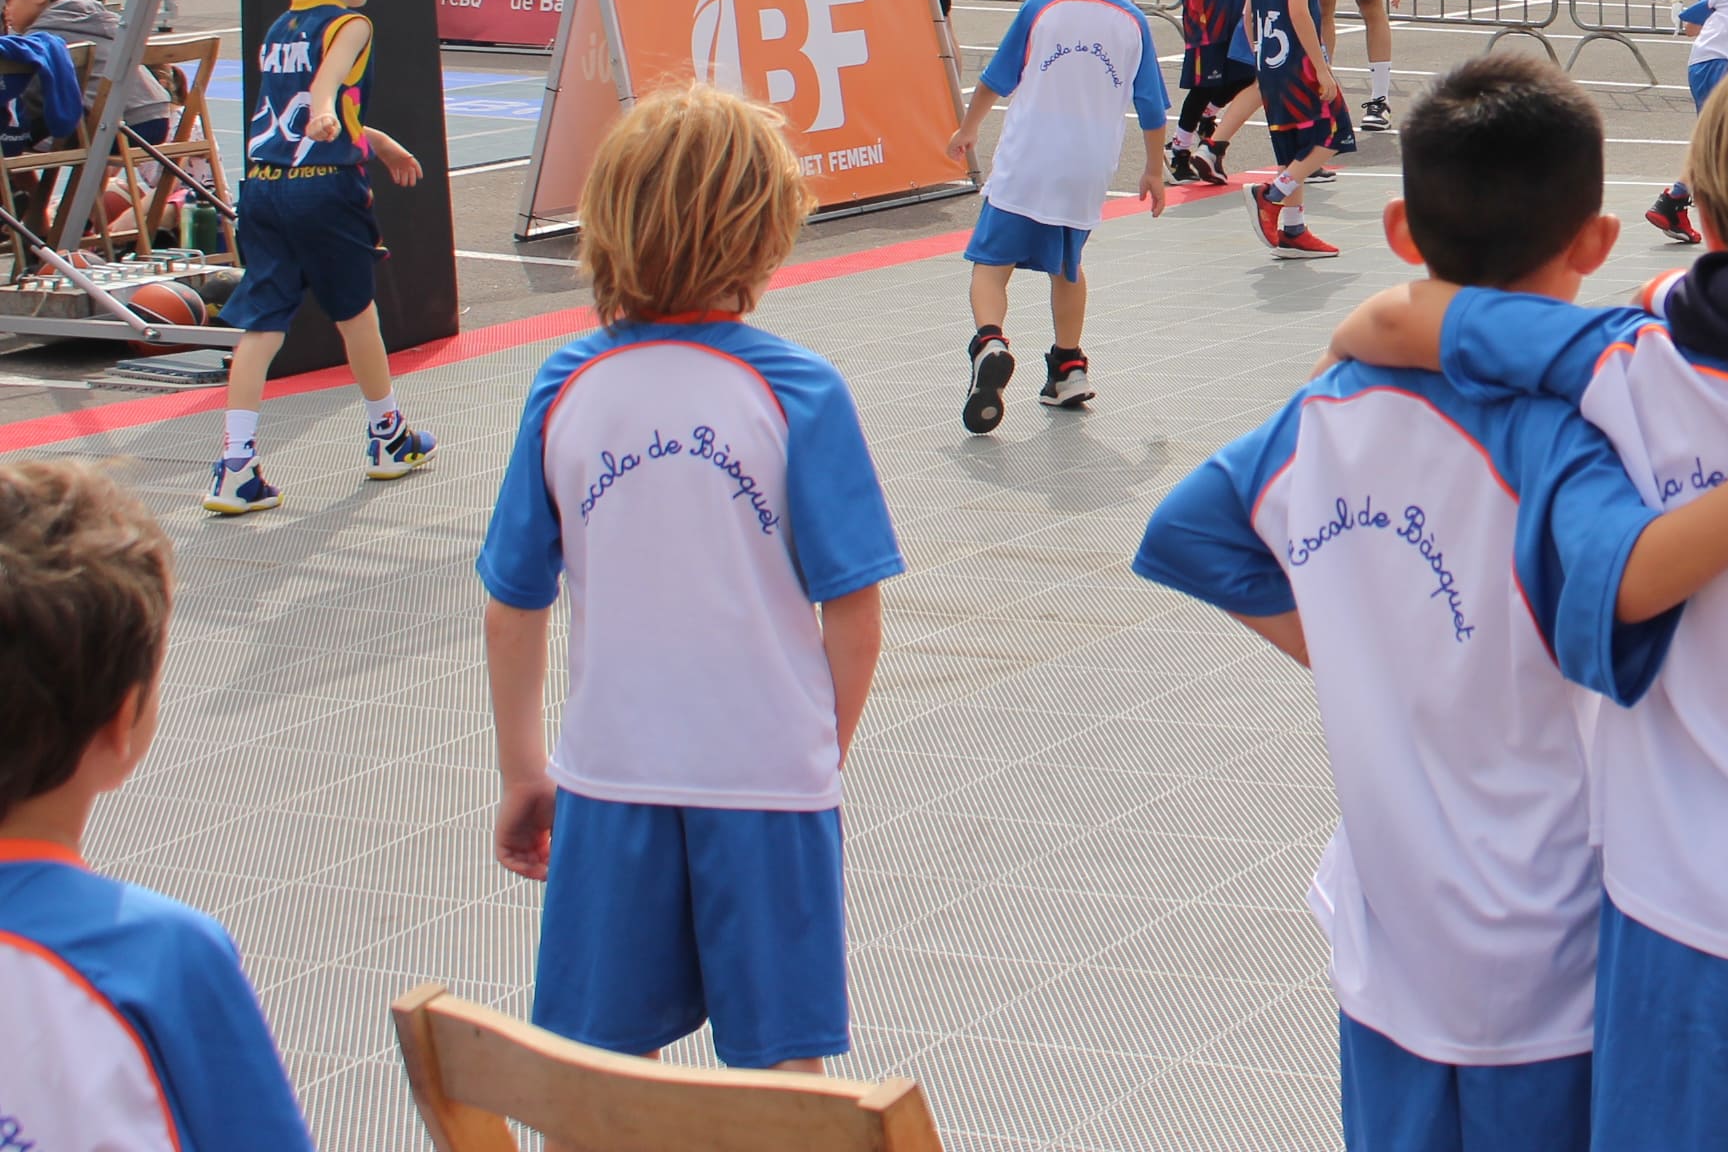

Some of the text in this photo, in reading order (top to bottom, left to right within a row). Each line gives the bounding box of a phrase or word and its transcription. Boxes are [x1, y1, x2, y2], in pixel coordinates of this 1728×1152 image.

[829, 137, 884, 173] FEMENÍ
[648, 430, 683, 459] de
[689, 425, 780, 535] Bàsquet
[1357, 495, 1391, 528] de
[1396, 505, 1475, 643] Bàsquet
